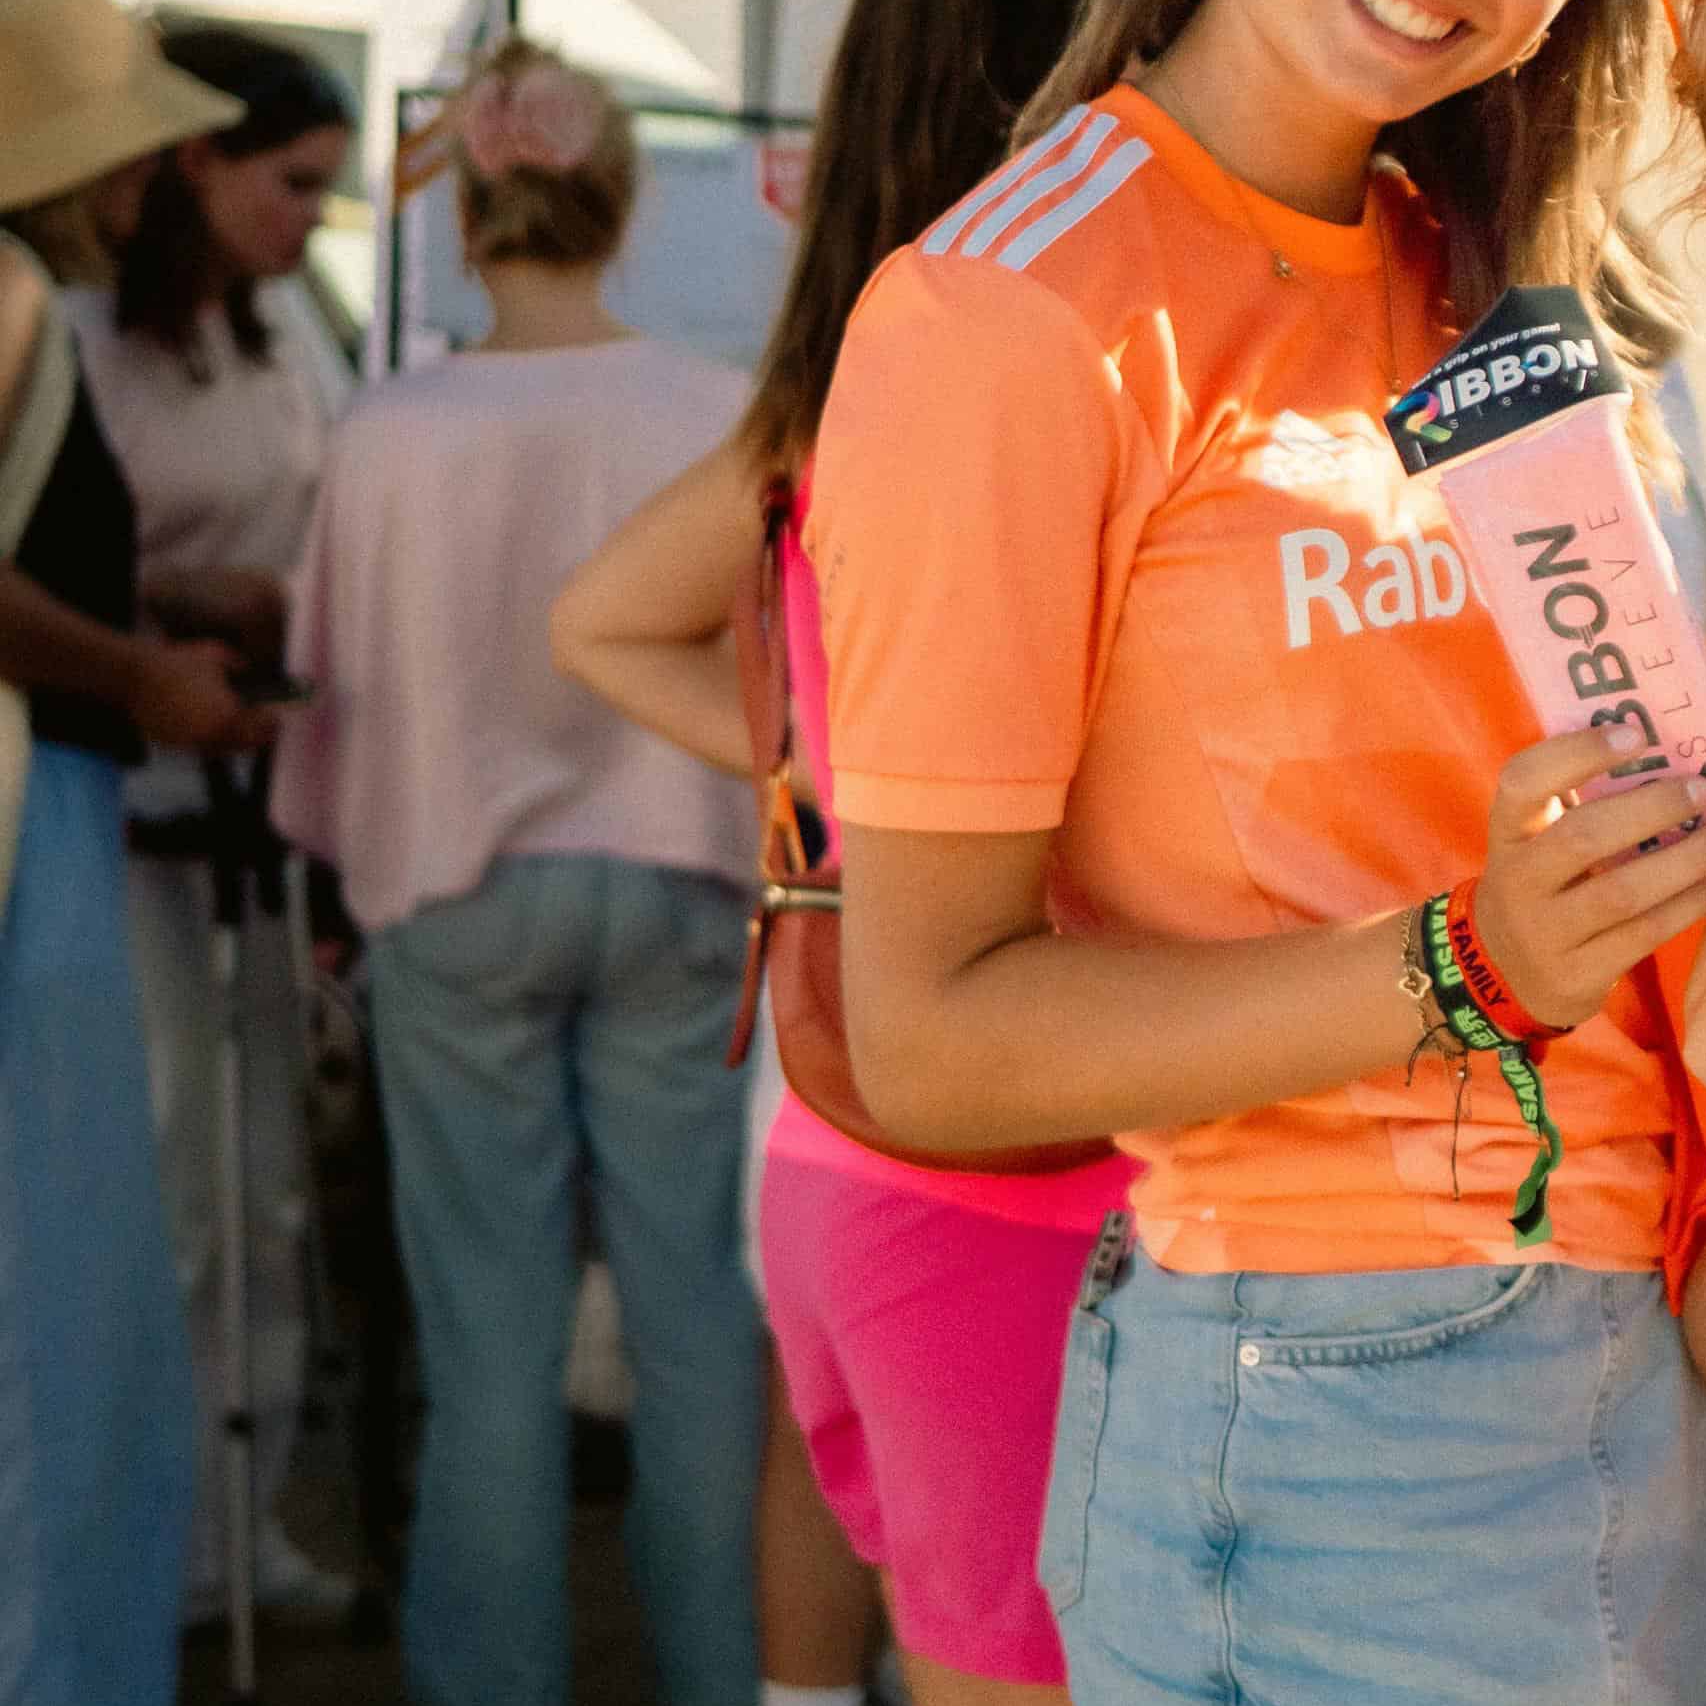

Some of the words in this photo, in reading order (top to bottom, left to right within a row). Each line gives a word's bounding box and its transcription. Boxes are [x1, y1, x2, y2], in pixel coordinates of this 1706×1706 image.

[1472, 344, 1489, 358] on
[1490, 331, 1519, 354] your
[1391, 339, 1599, 443] RIBBON
[1452, 917, 1512, 1006] FAMILY
